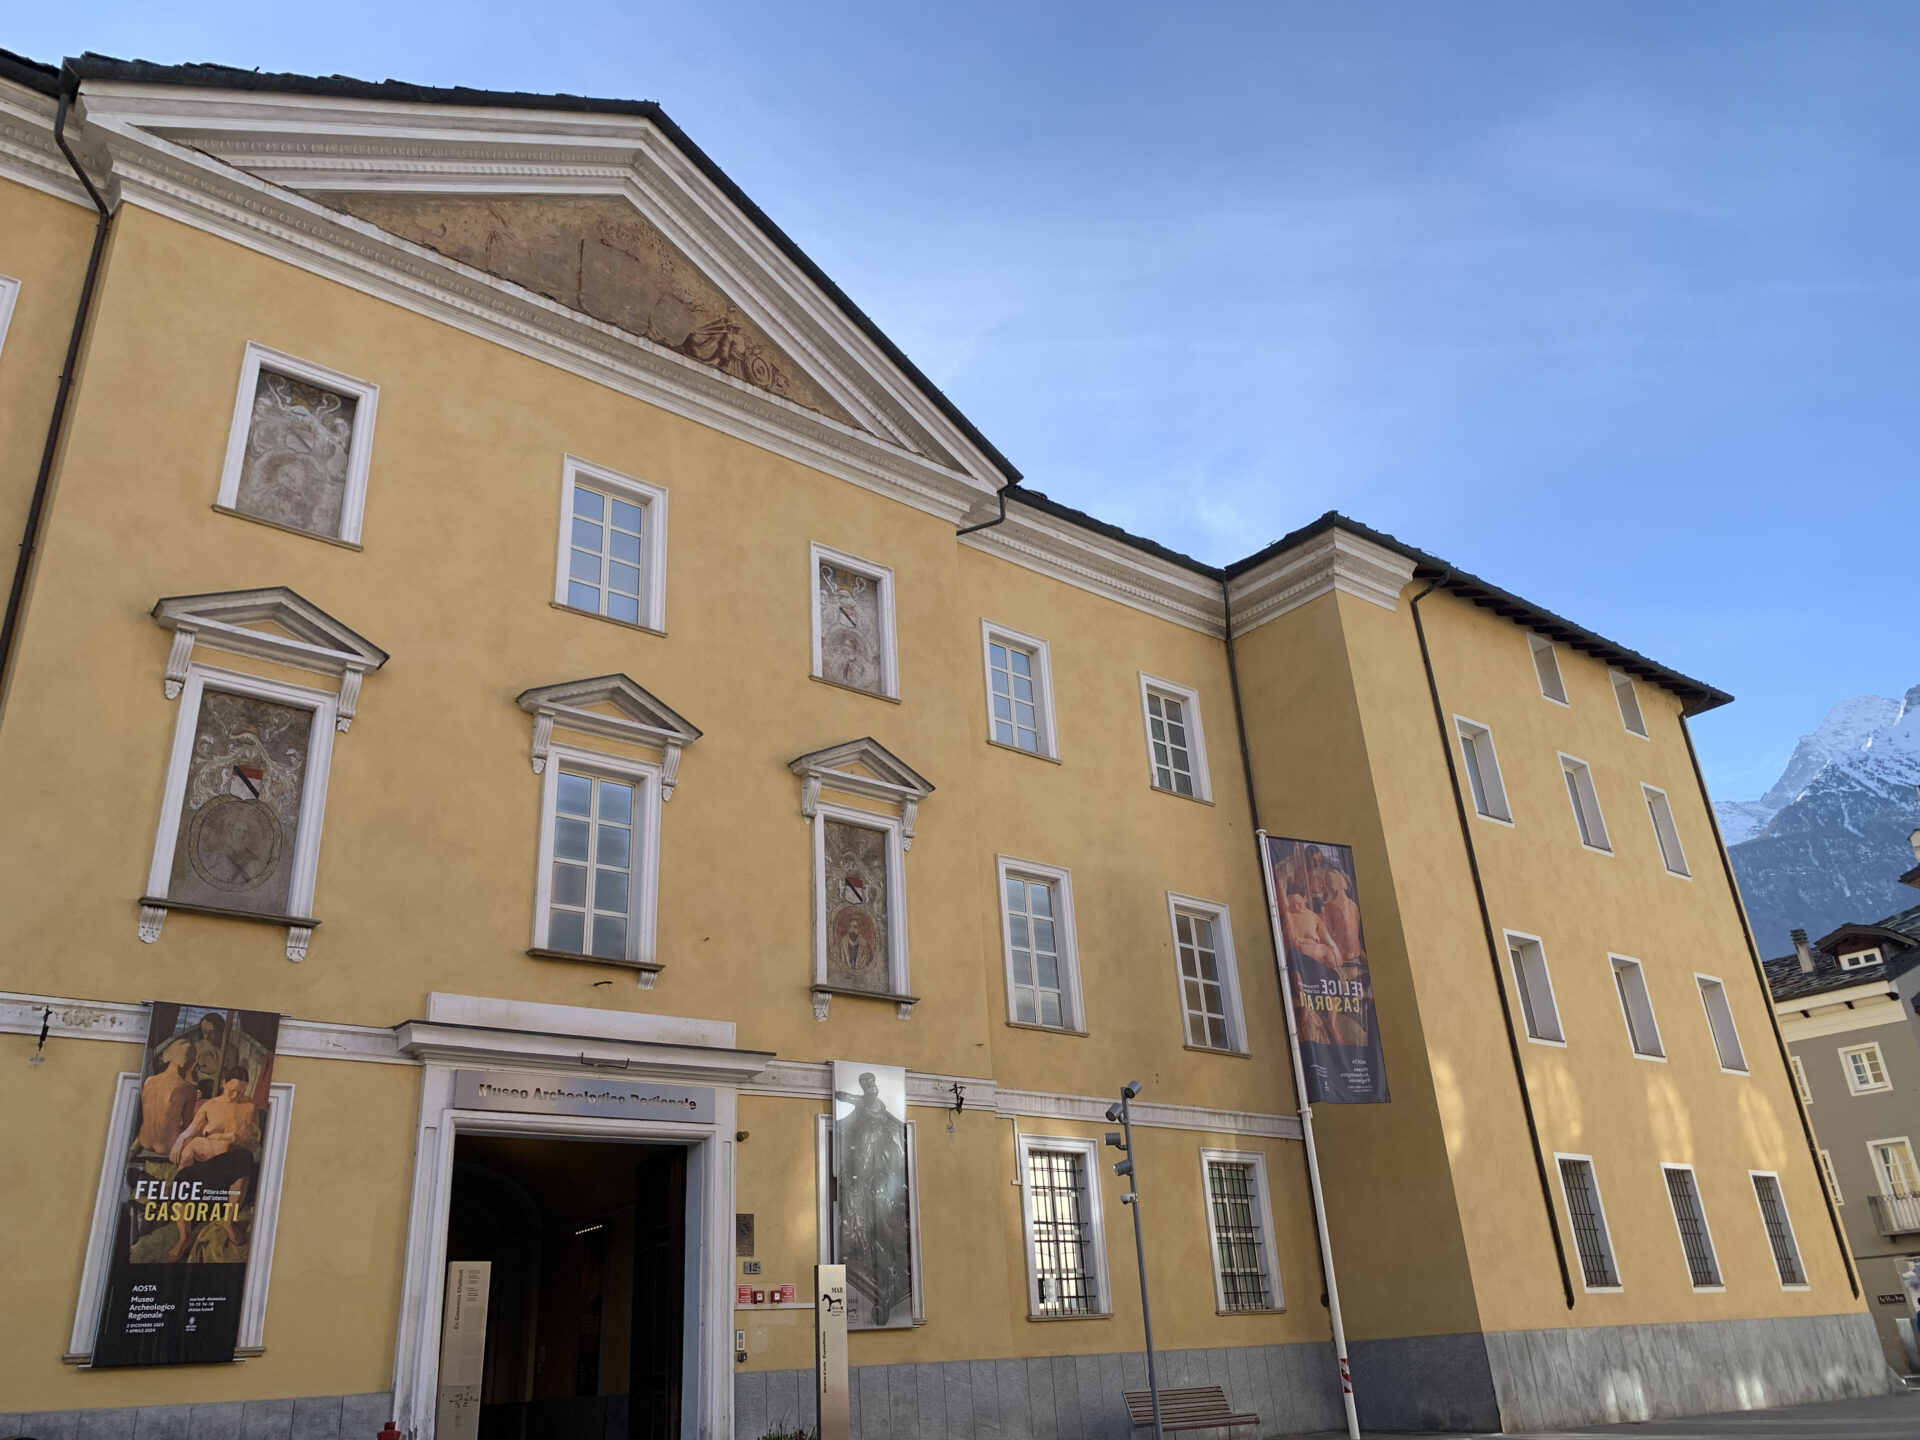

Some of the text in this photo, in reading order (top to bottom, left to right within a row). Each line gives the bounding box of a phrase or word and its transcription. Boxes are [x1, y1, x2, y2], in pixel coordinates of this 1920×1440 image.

[479, 1084, 529, 1099] Museo
[533, 1088, 626, 1106] Archeologico
[135, 1180, 202, 1200] FELICE
[144, 1201, 239, 1221] CASORATI
[748, 1263, 758, 1272] 12
[132, 1284, 157, 1292] AOSTA
[129, 1303, 176, 1312] Archeologico
[128, 1312, 163, 1321] Regionale
